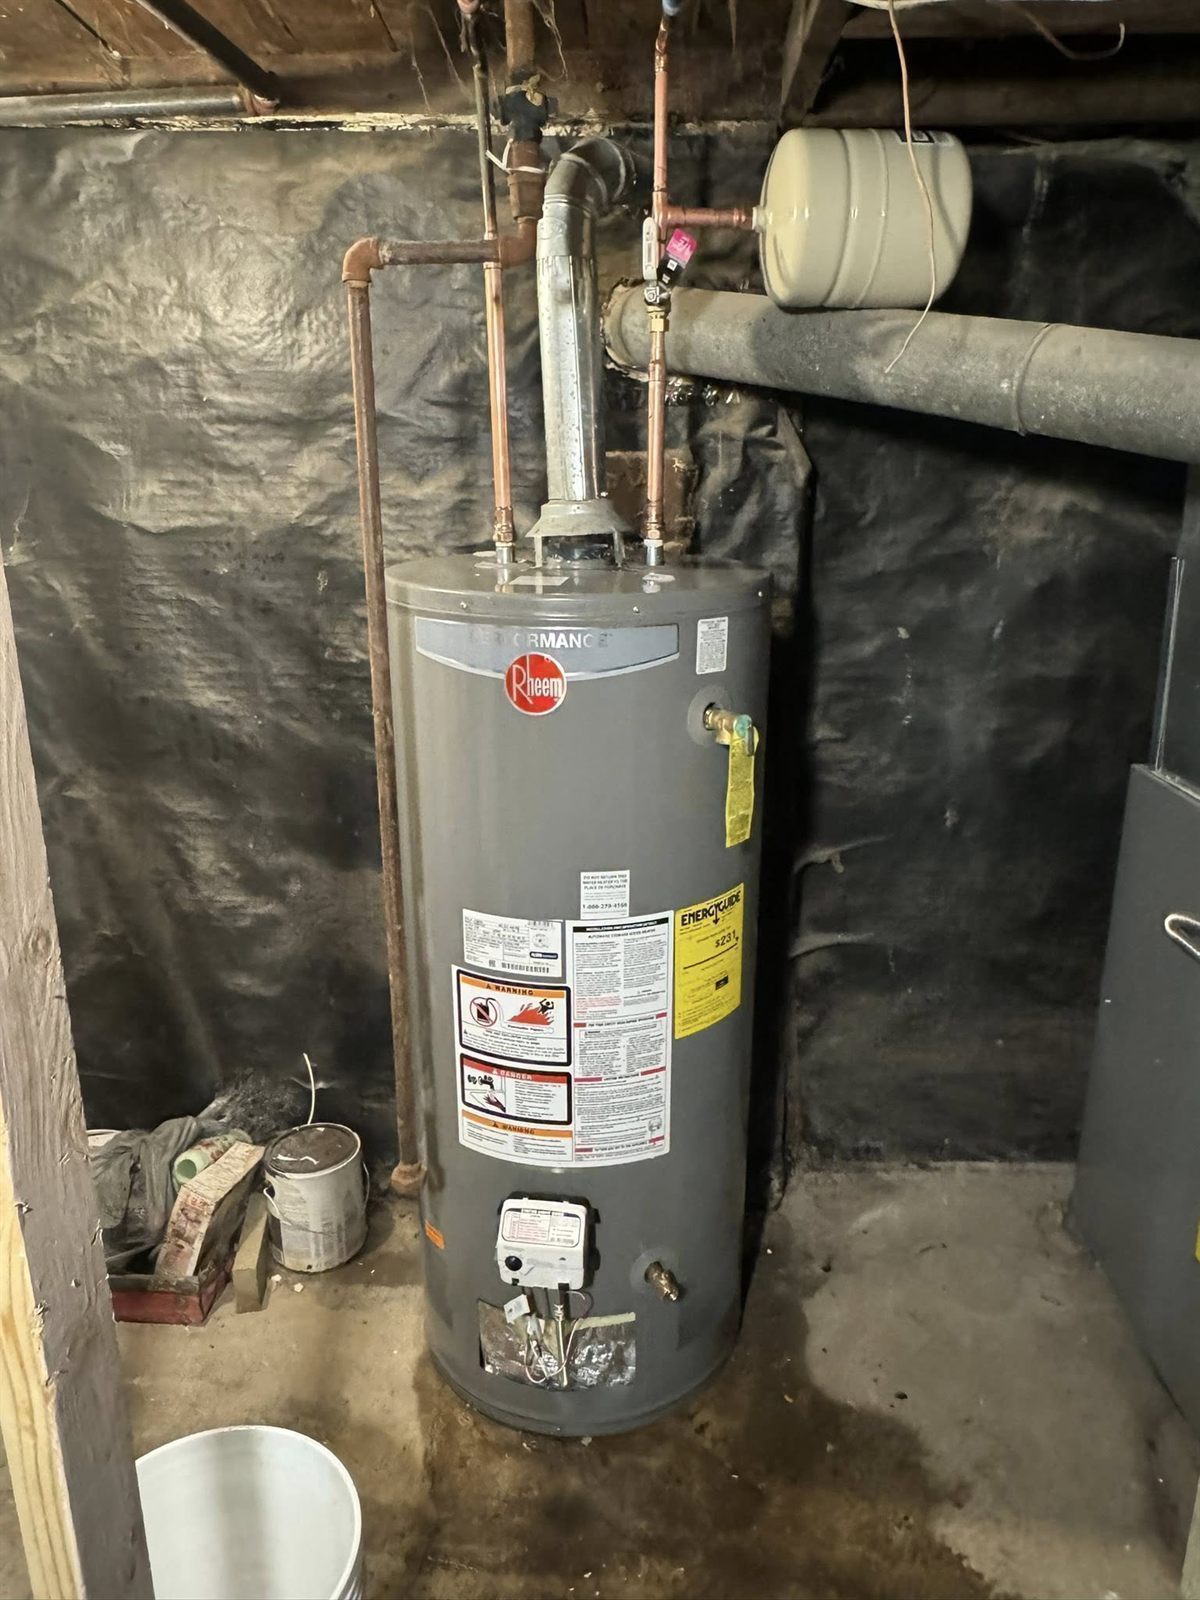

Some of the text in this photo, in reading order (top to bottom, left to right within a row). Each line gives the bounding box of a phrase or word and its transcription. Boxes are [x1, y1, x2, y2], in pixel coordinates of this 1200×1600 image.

[512, 653, 563, 704] Rheem
[715, 929, 736, 948] $231
[495, 985, 534, 996] WARNING
[500, 1071, 533, 1081] DANGER
